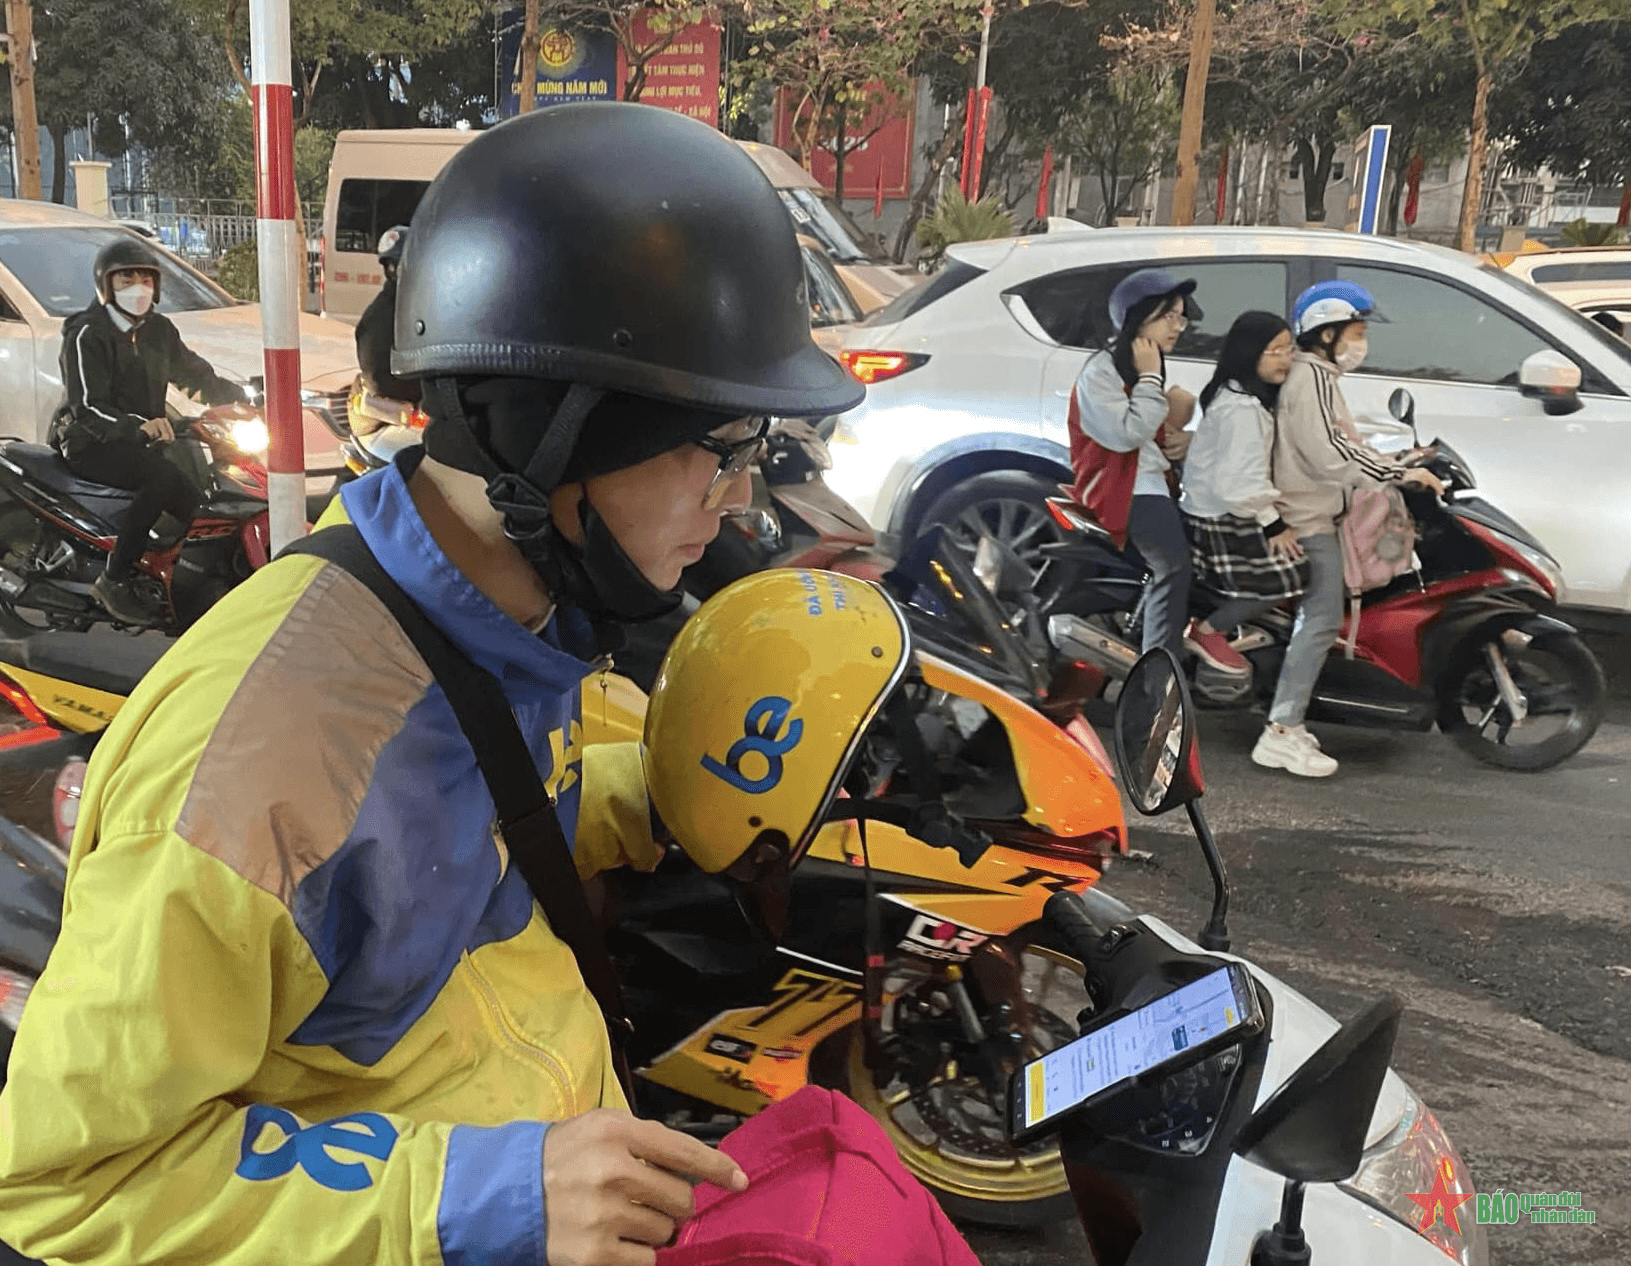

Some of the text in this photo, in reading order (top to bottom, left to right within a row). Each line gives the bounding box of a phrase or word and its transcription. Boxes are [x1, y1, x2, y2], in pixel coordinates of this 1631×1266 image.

[537, 80, 563, 94] MỪNG
[566, 80, 587, 94] NĂM
[589, 79, 608, 94] MỚI
[700, 696, 804, 794] be
